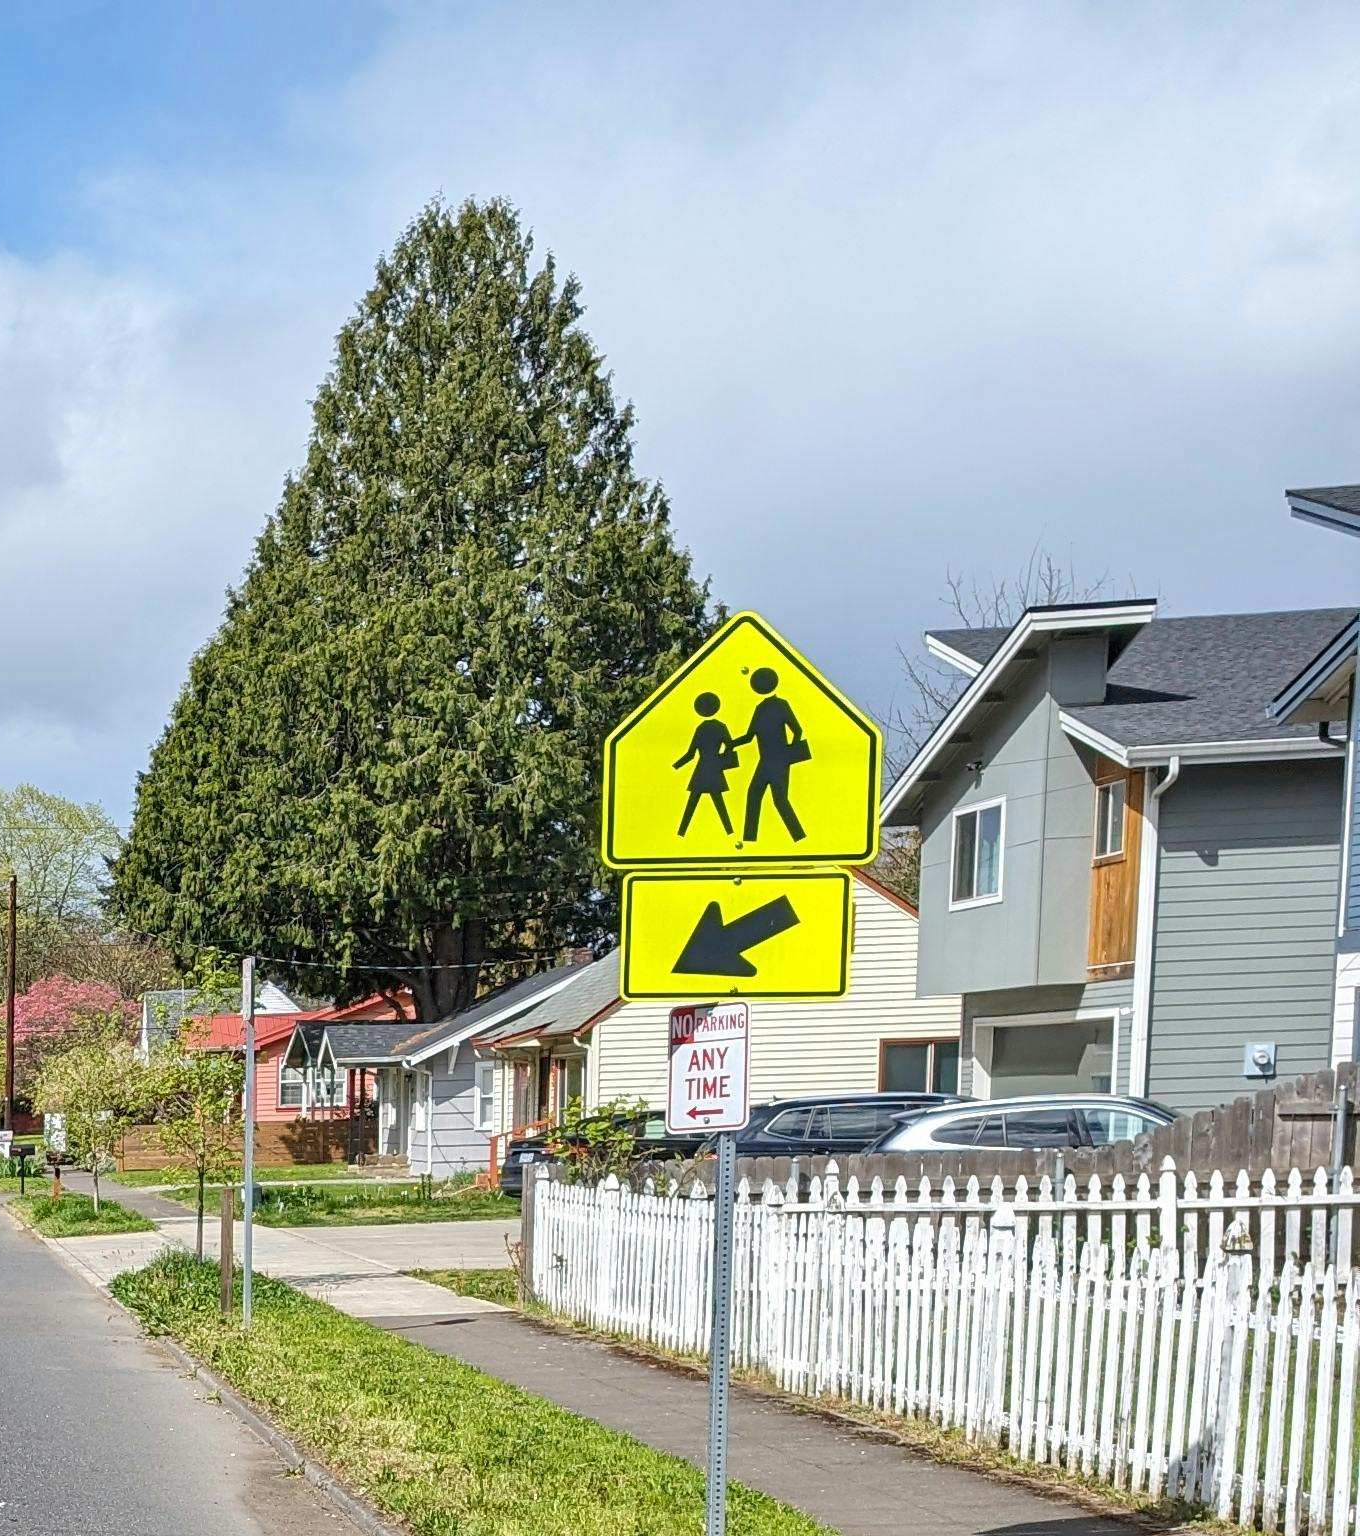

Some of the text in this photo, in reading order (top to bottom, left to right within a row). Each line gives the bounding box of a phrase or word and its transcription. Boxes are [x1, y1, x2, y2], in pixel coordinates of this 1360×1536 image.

[671, 1012, 745, 1039] NO PARKING
[688, 1047, 729, 1072] ANY
[685, 1075, 731, 1100] TIME
